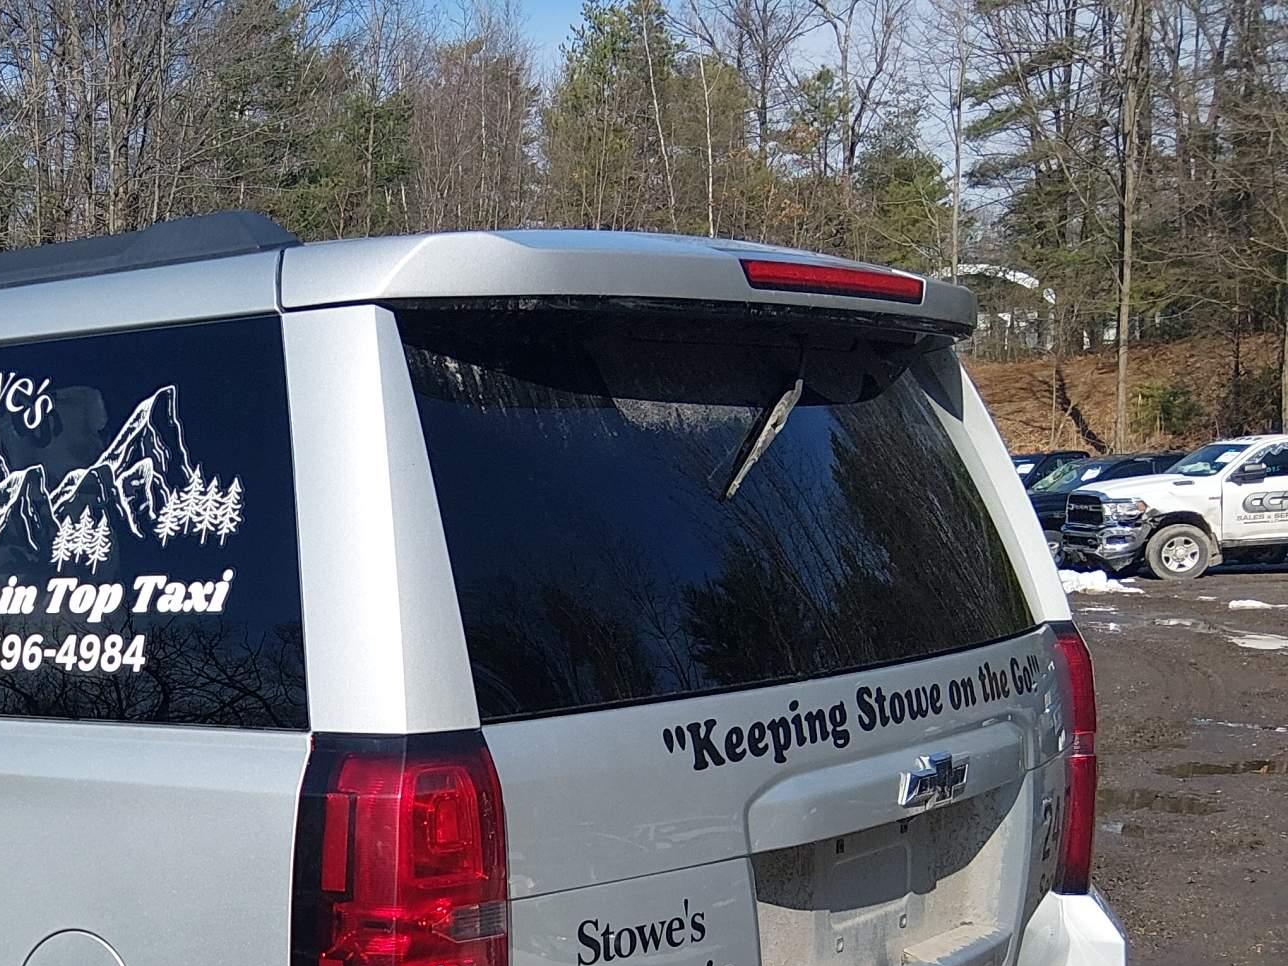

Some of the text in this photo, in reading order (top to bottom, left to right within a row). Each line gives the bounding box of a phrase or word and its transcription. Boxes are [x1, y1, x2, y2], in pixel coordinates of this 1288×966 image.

[46, 577, 123, 624] Top
[129, 568, 234, 613] Taxi
[663, 655, 1041, 771] "Keeping Stowe on the Go!"
[576, 898, 706, 966] Stowe's
